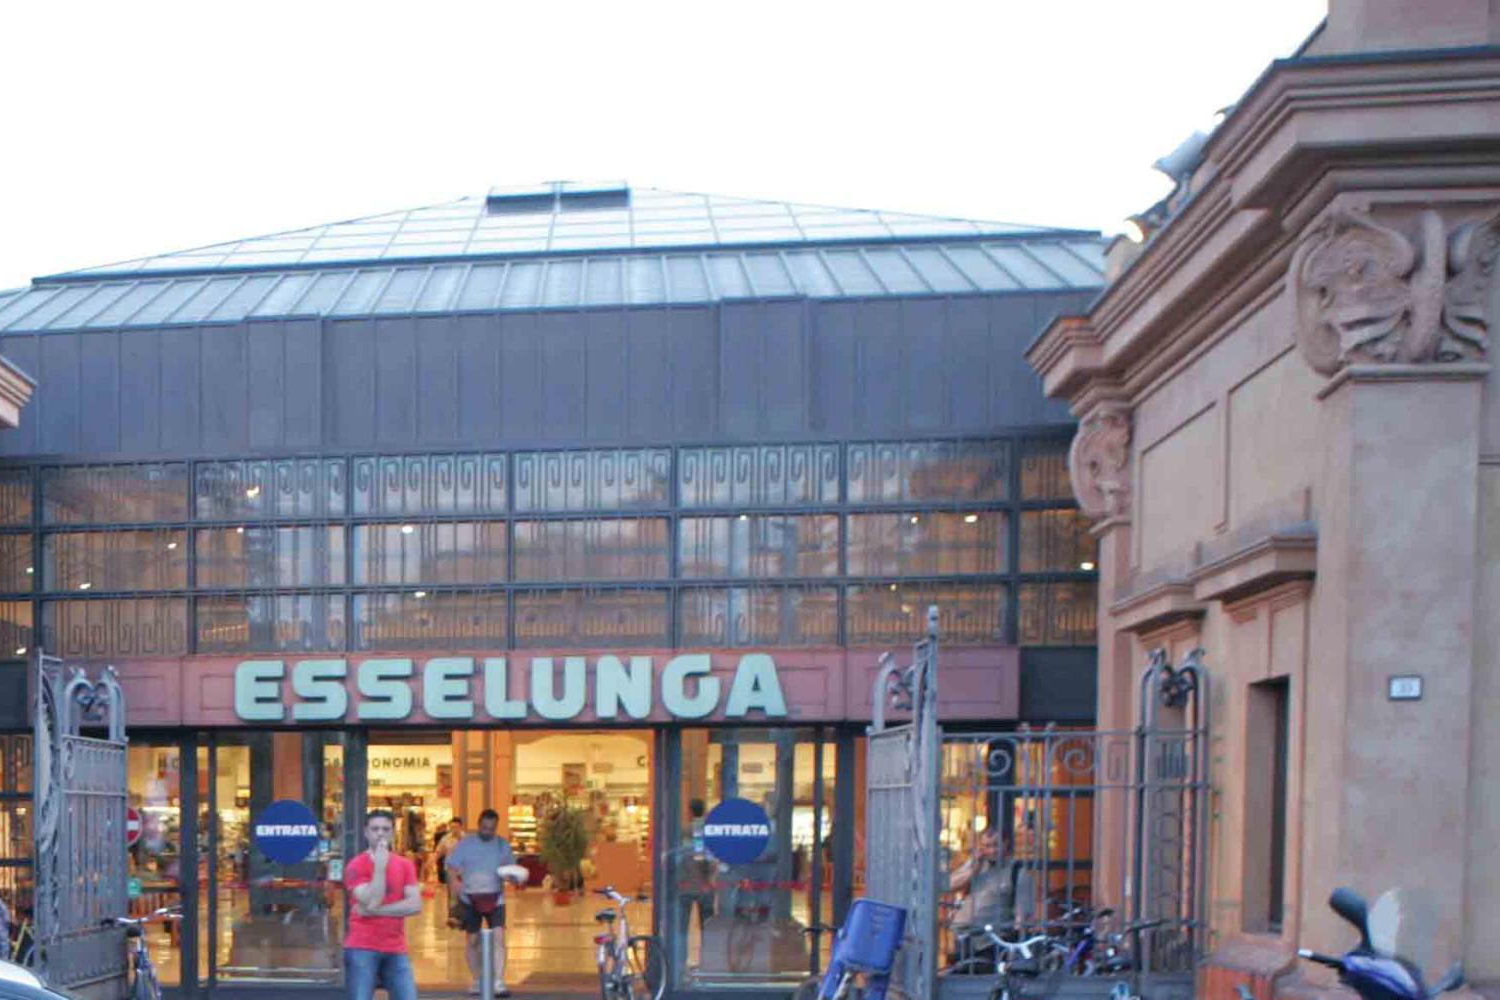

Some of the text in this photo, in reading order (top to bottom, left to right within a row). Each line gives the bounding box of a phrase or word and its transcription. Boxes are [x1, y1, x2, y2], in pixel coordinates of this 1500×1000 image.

[234, 653, 788, 721] ESSELUNGA
[256, 824, 318, 836] ENTRATA
[704, 824, 769, 836] ENTRATA
